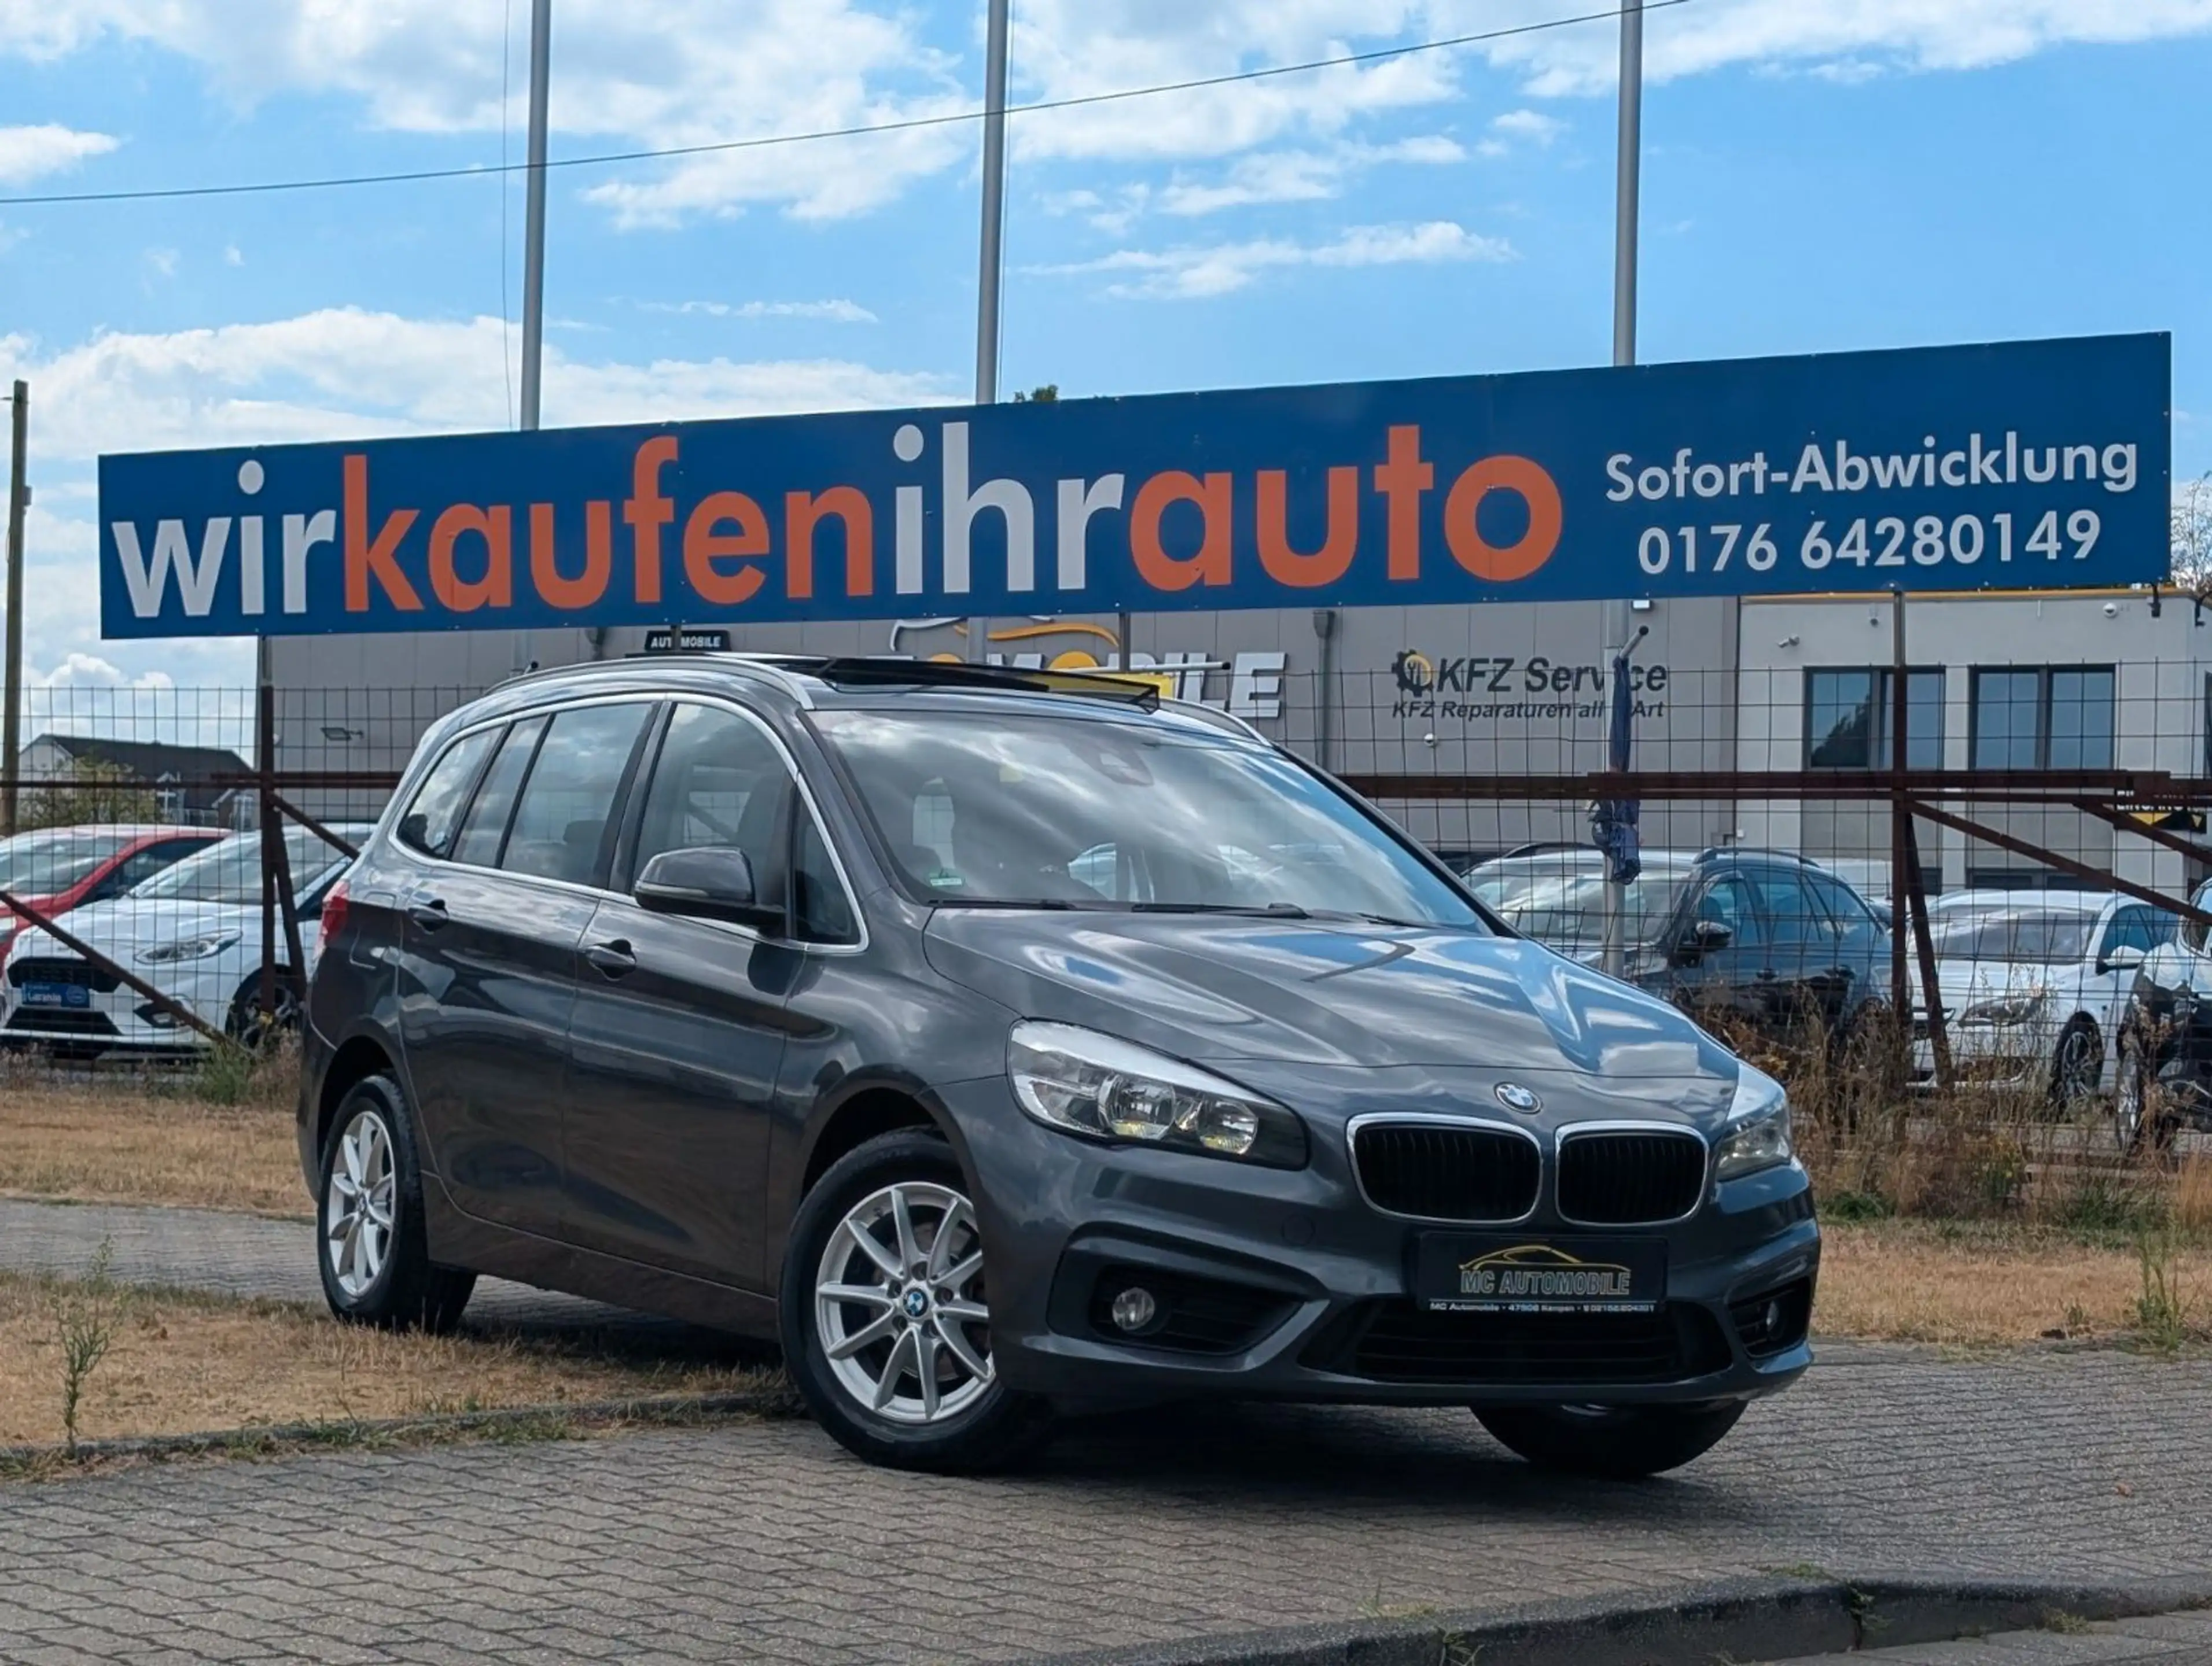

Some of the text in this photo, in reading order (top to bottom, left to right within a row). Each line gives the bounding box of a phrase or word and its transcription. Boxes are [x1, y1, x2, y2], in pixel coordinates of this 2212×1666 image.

[1606, 432, 2136, 501] Sofort-Abwicklung
[1638, 510, 2100, 574] 0176 64280149
[650, 636, 722, 648] AUTMOBILE
[1437, 657, 1667, 692] KFZ Servce
[1392, 701, 1436, 718] KFZ
[1441, 701, 1571, 722] Reparaturen
[1631, 700, 1665, 718] Art
[1460, 1270, 1631, 1295] MC AUTOMOBILE
